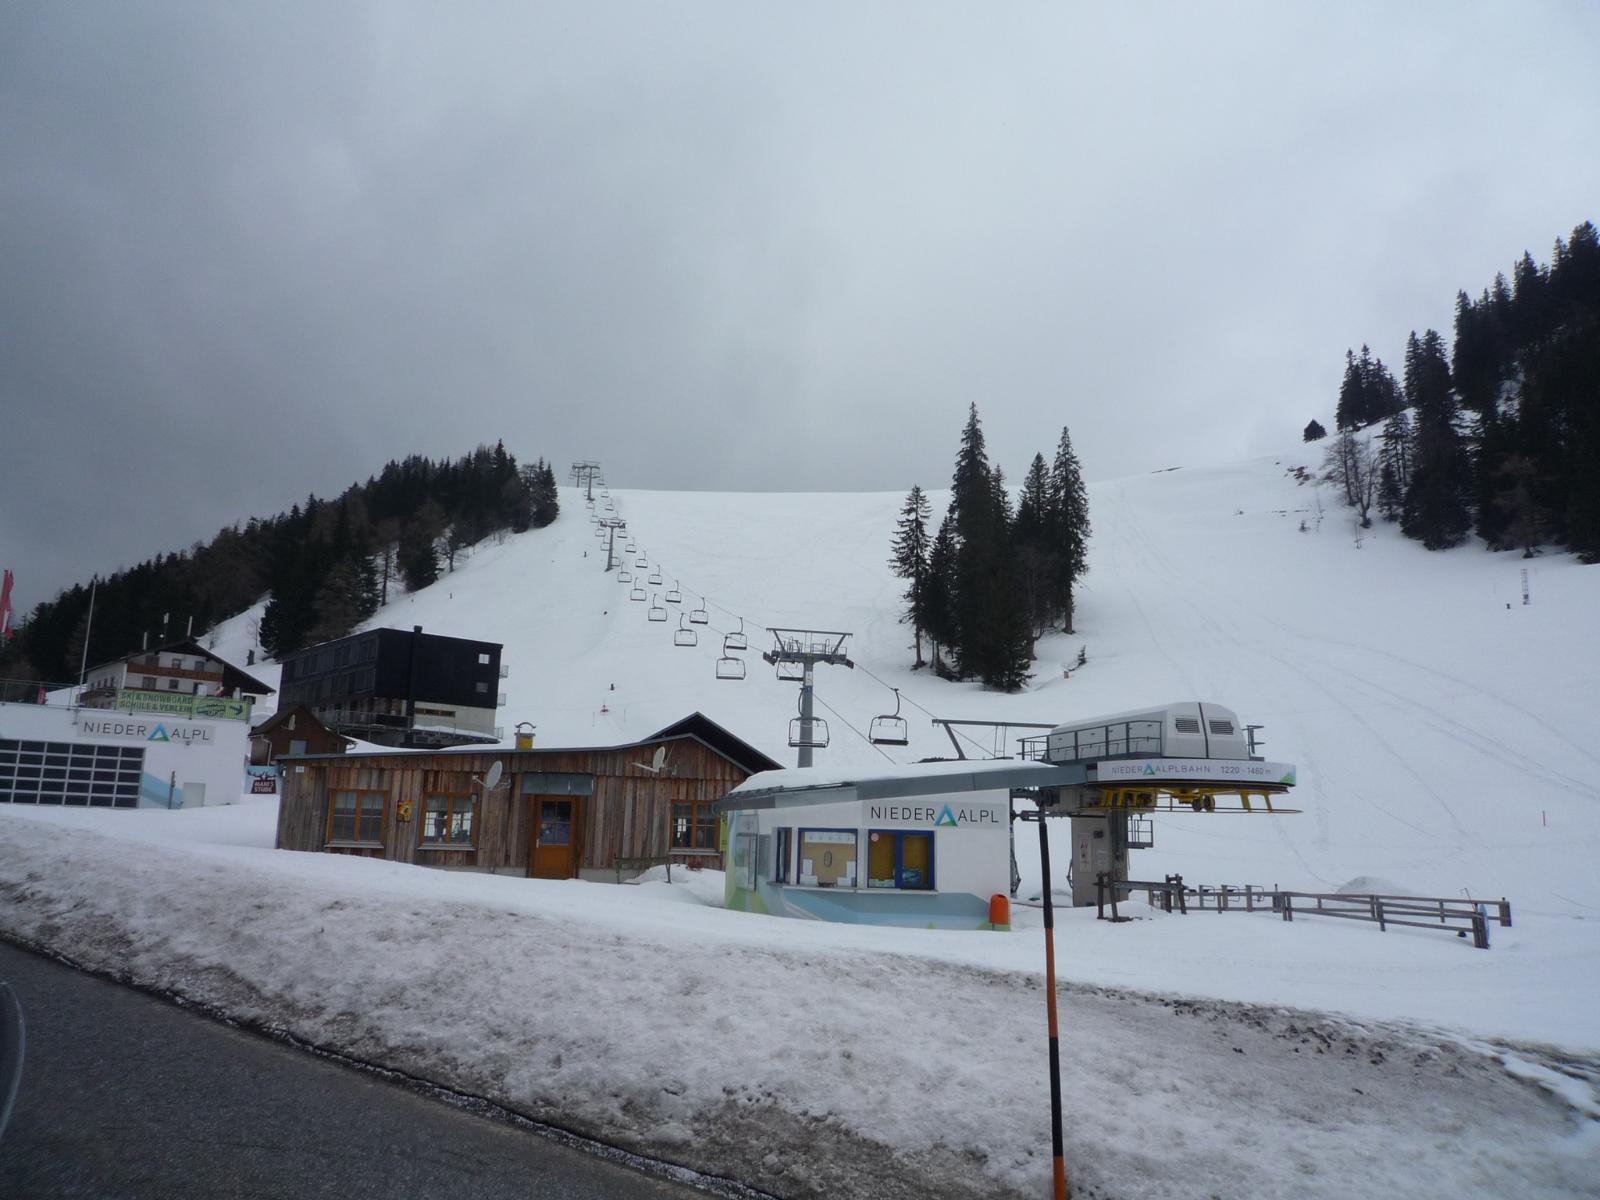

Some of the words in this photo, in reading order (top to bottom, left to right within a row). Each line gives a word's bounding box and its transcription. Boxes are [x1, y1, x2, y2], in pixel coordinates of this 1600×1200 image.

[143, 692, 192, 705] SNOWBOARD
[84, 721, 147, 737] NIEDER
[171, 728, 210, 741] ALPL
[1111, 766, 1143, 775] NIEDER
[1155, 764, 1211, 775] ALPLBAHN
[1220, 766, 1240, 775] 1220
[1247, 766, 1264, 776] 1460
[870, 805, 935, 822] NIEDER
[957, 808, 1000, 823] ALPL
